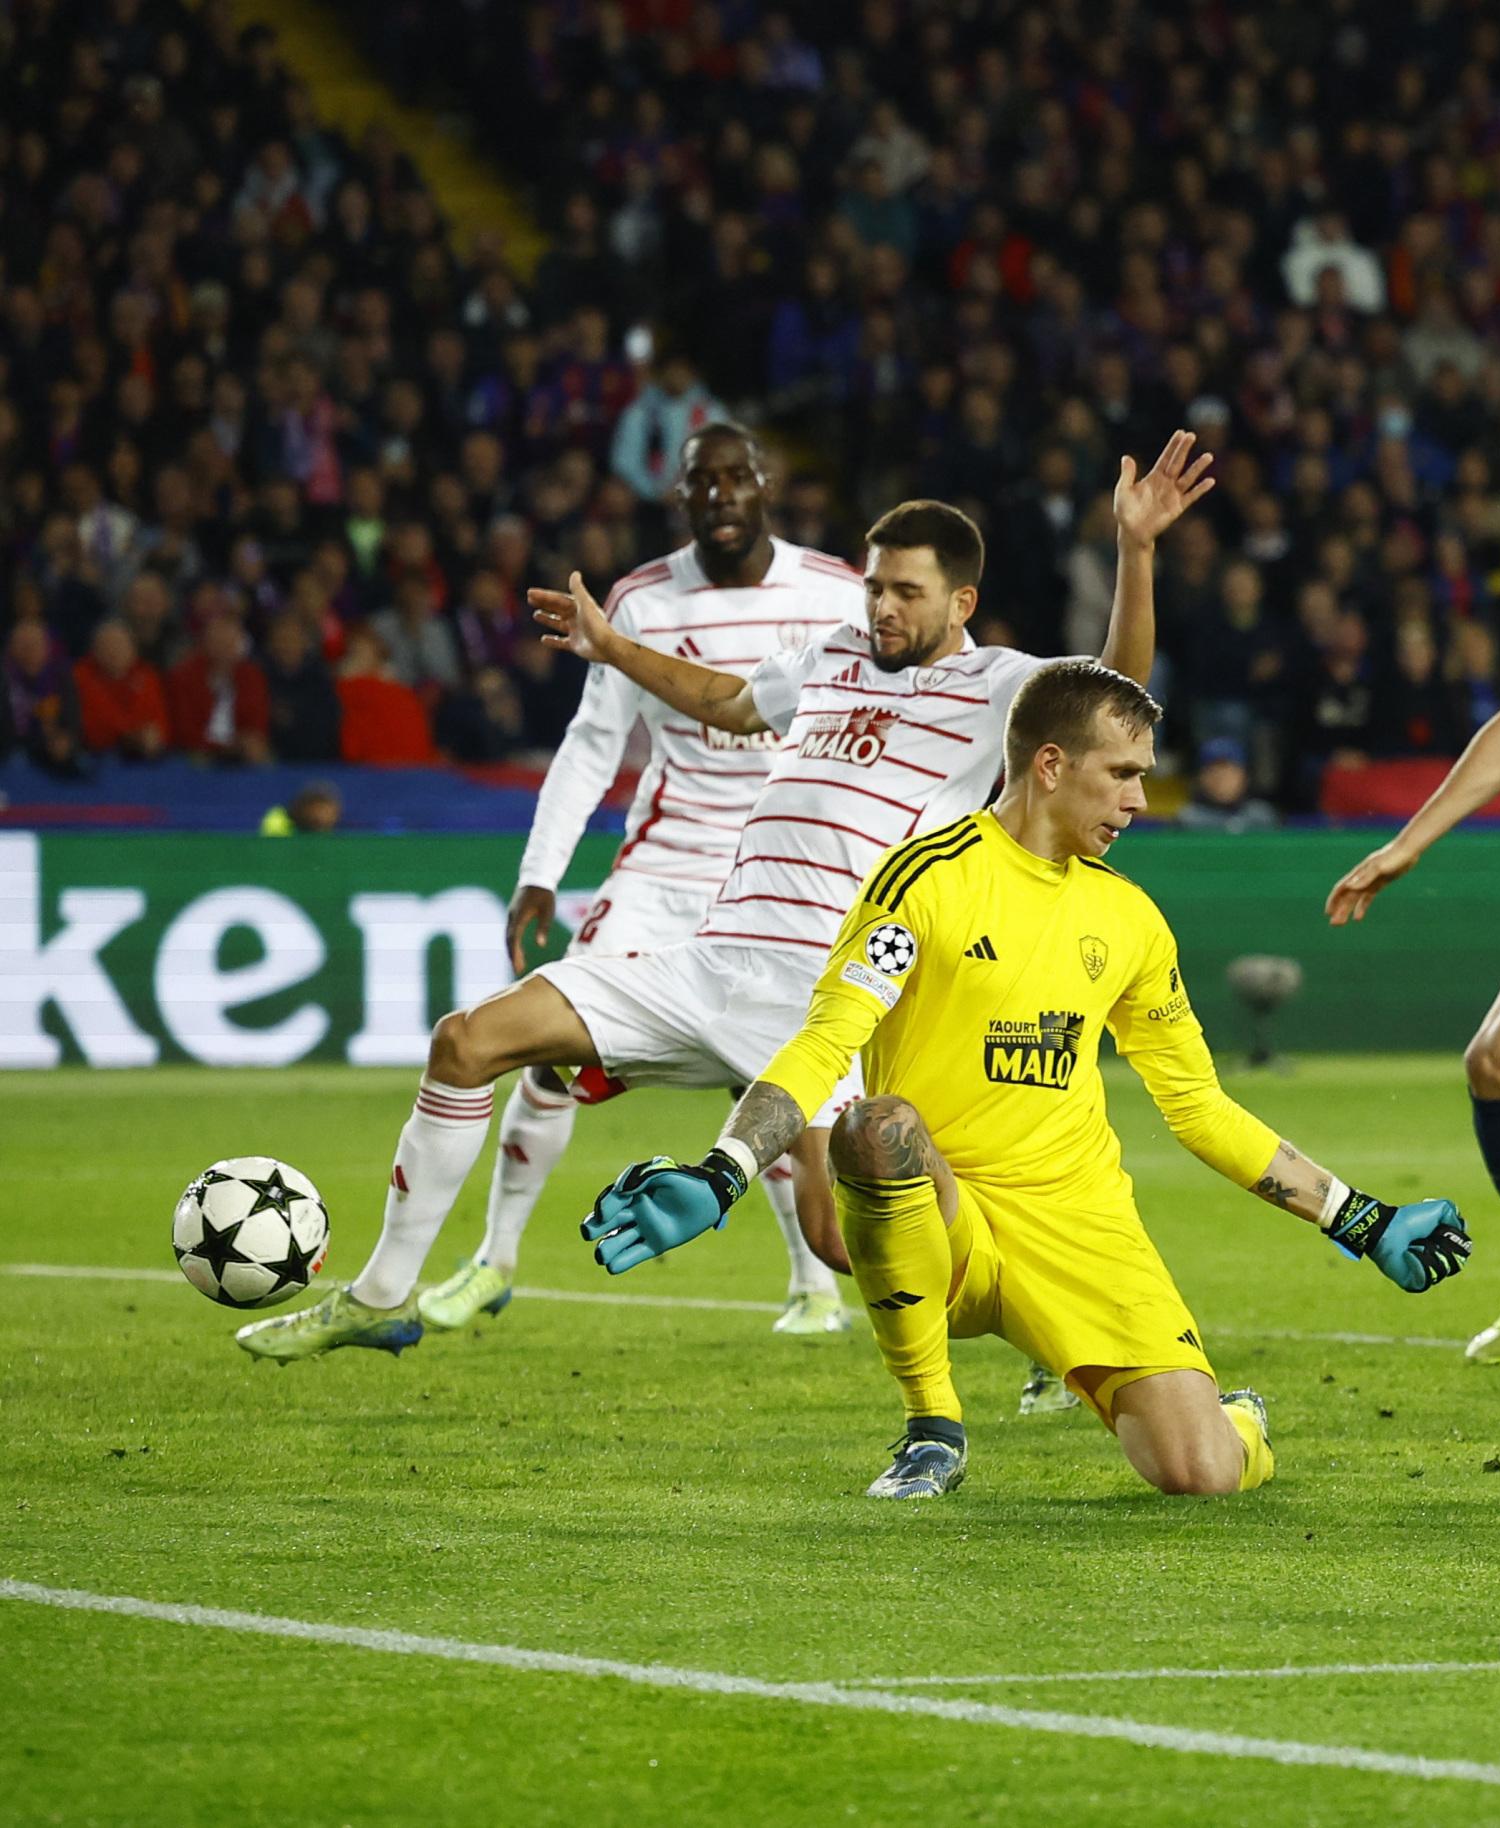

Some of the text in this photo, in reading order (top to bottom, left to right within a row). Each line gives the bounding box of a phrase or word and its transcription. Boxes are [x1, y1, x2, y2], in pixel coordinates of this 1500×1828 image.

[799, 733, 880, 766] MALO
[577, 899, 612, 944] 2
[988, 1020, 1037, 1034] YAOURT
[990, 1047, 1072, 1088] MALO
